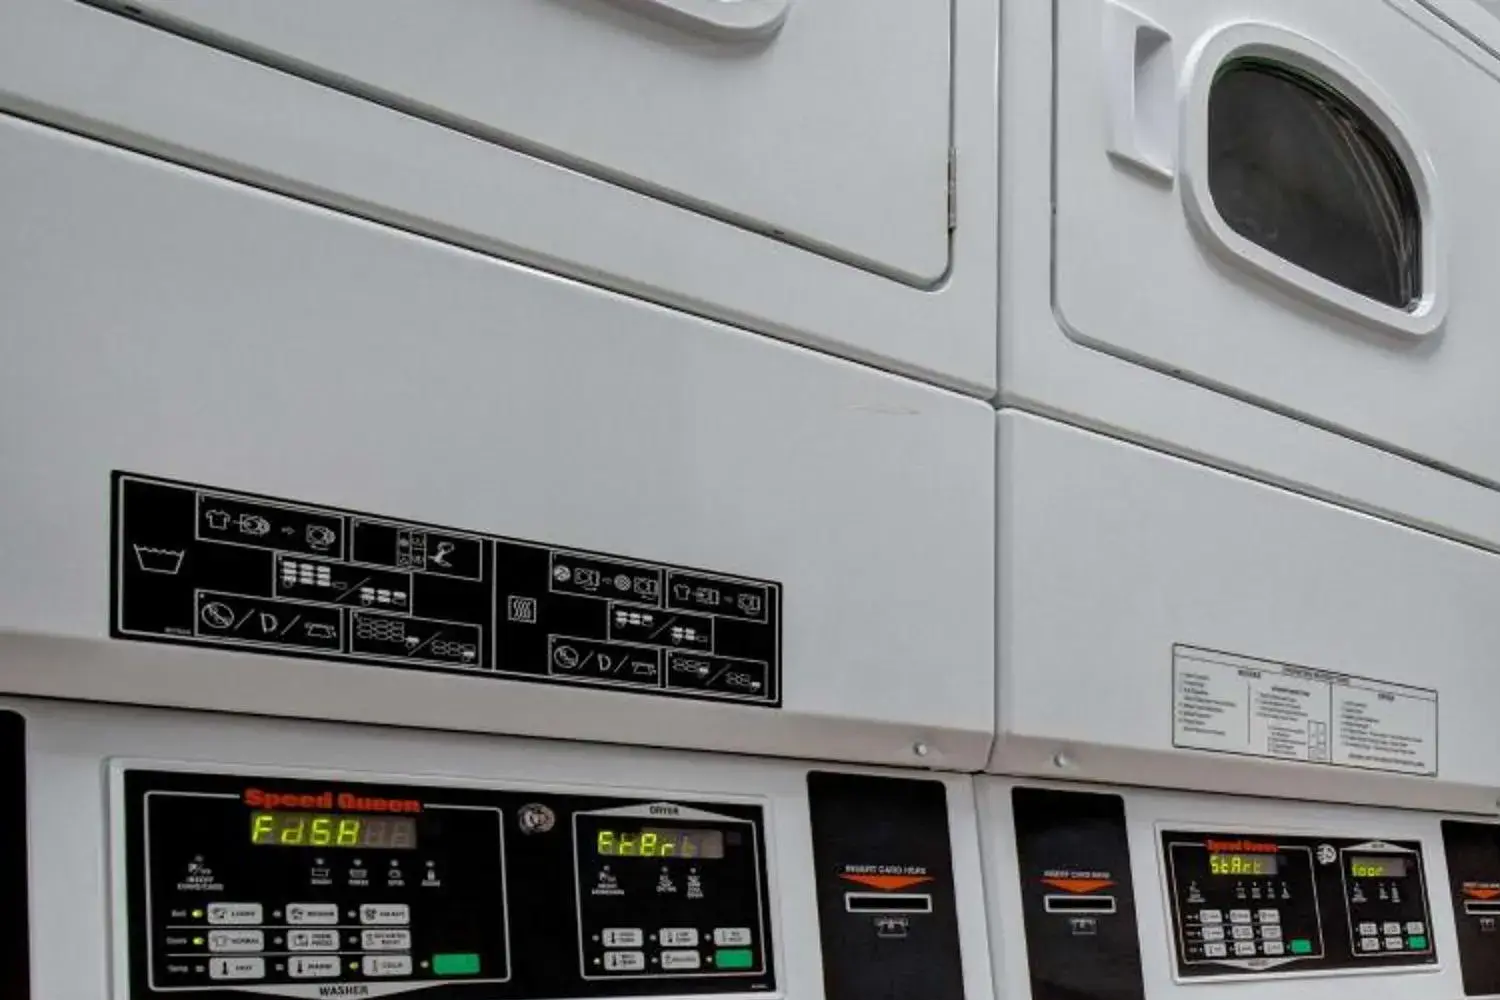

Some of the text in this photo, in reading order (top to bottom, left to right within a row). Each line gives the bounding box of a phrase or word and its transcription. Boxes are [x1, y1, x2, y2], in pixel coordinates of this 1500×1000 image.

[244, 788, 421, 812] Speed Queen
[319, 985, 369, 997] WASHER
